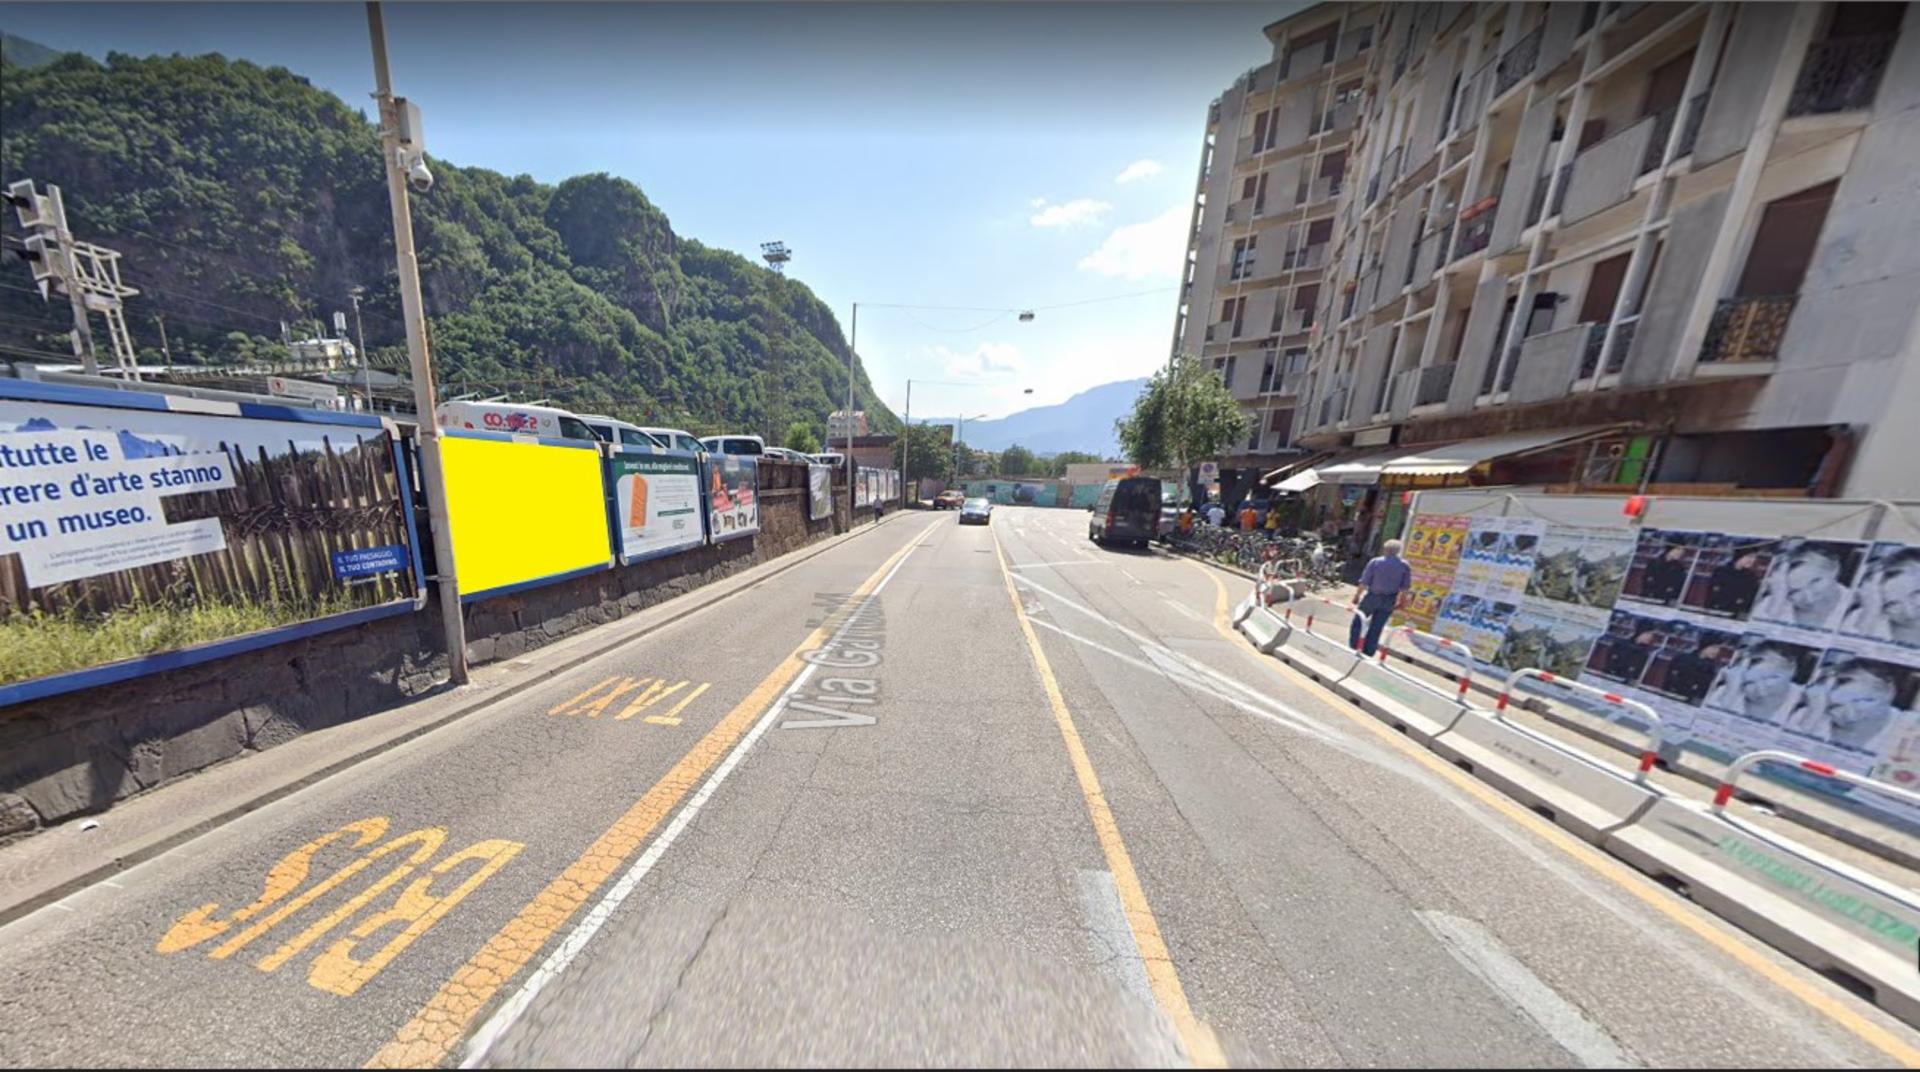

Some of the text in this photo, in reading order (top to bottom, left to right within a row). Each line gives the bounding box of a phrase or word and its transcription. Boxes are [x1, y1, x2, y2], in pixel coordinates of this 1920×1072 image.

[83, 438, 109, 461] le
[0, 465, 222, 506] rere d'arte stanno
[6, 506, 152, 542] un museo.
[156, 816, 526, 997] BUS
